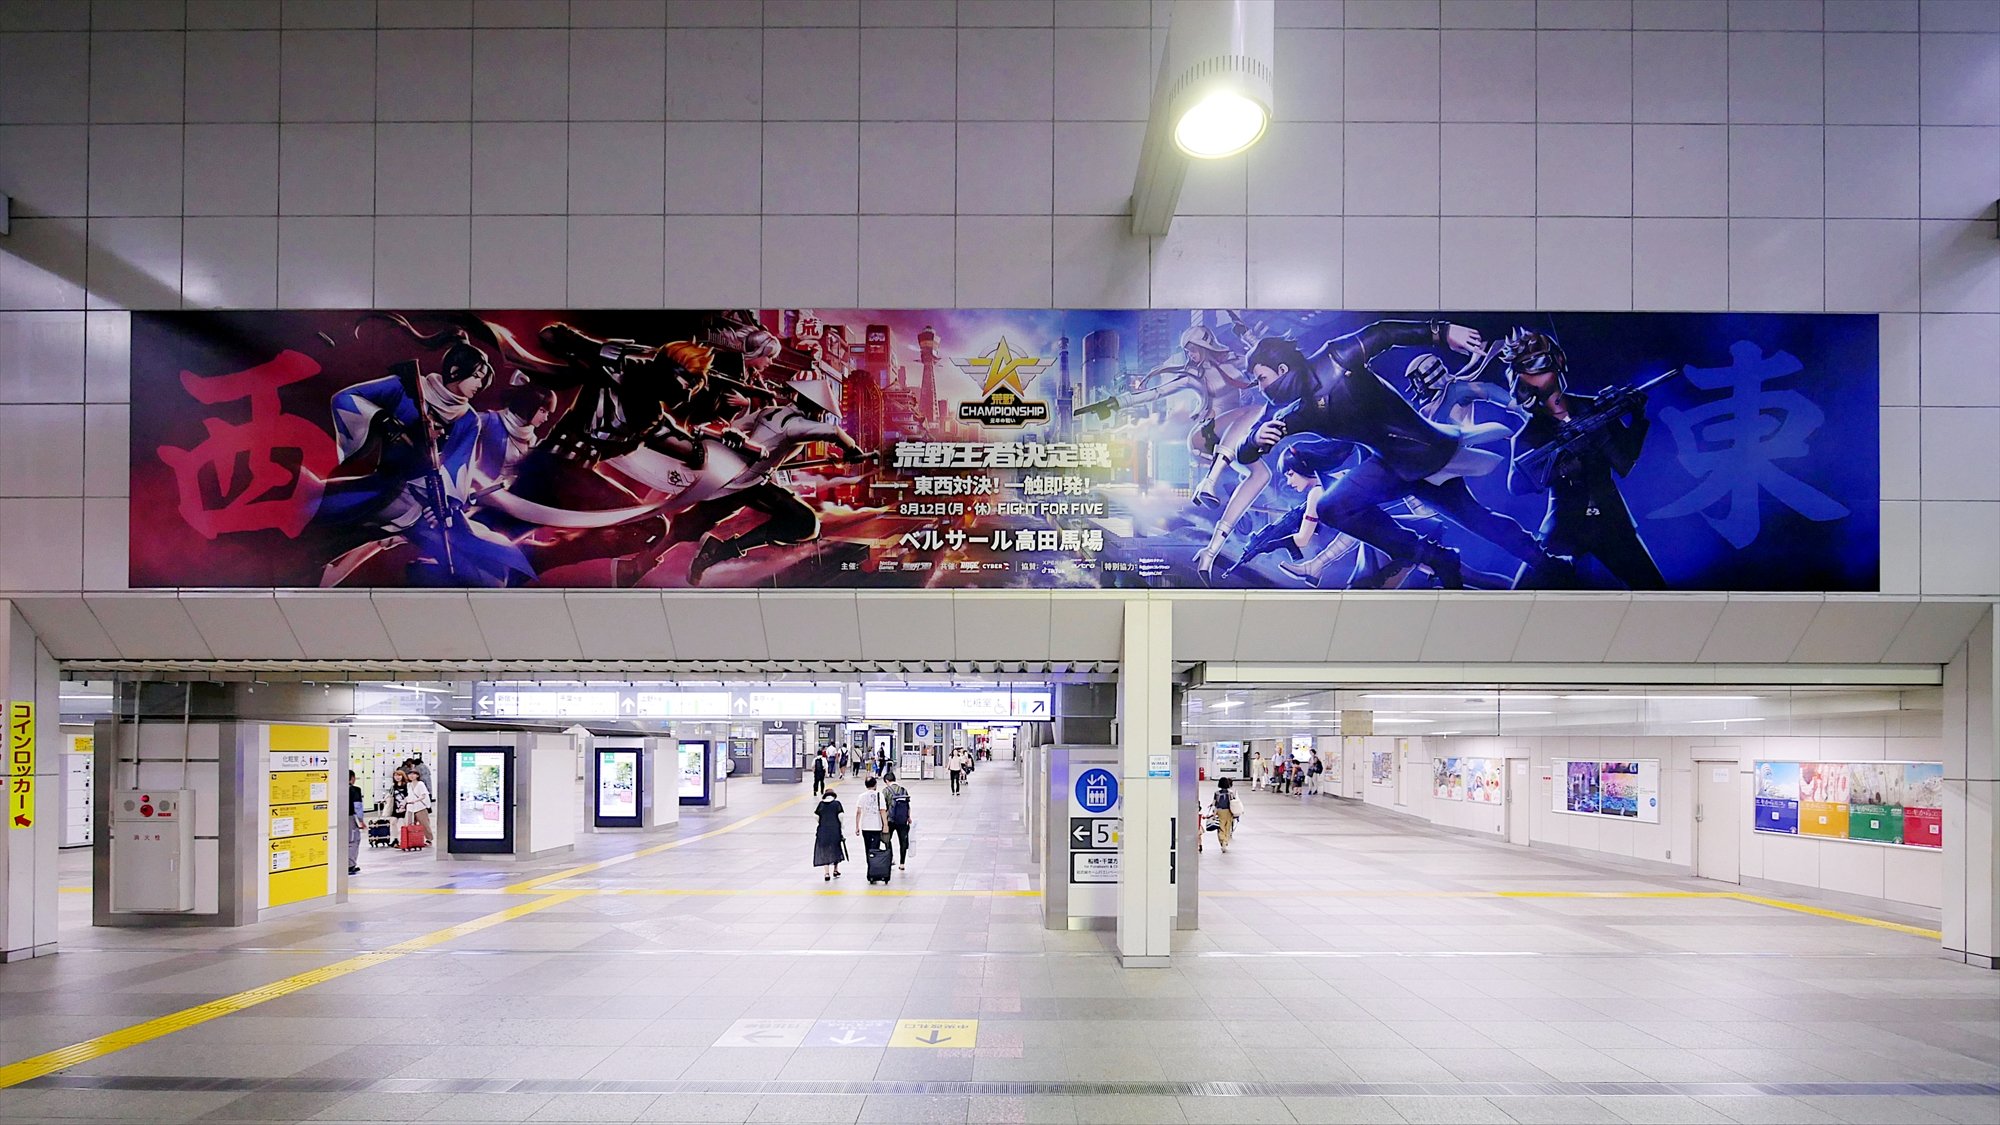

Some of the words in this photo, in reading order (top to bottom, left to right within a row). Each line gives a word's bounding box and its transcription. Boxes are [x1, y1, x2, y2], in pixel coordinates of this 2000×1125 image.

[960, 405, 1045, 417] CHAMPIONSHIP
[157, 348, 338, 540] 西
[893, 441, 1112, 469] 荒野王者決定戦
[1647, 340, 1851, 549] 東
[997, 503, 1038, 516] FIGHT
[1040, 503, 1069, 516] FOR
[1070, 503, 1104, 516] FIVE
[899, 529, 1104, 552] ベルサール高田馬場
[13, 704, 32, 810] コインロッカー
[1097, 823, 1109, 843] 5
